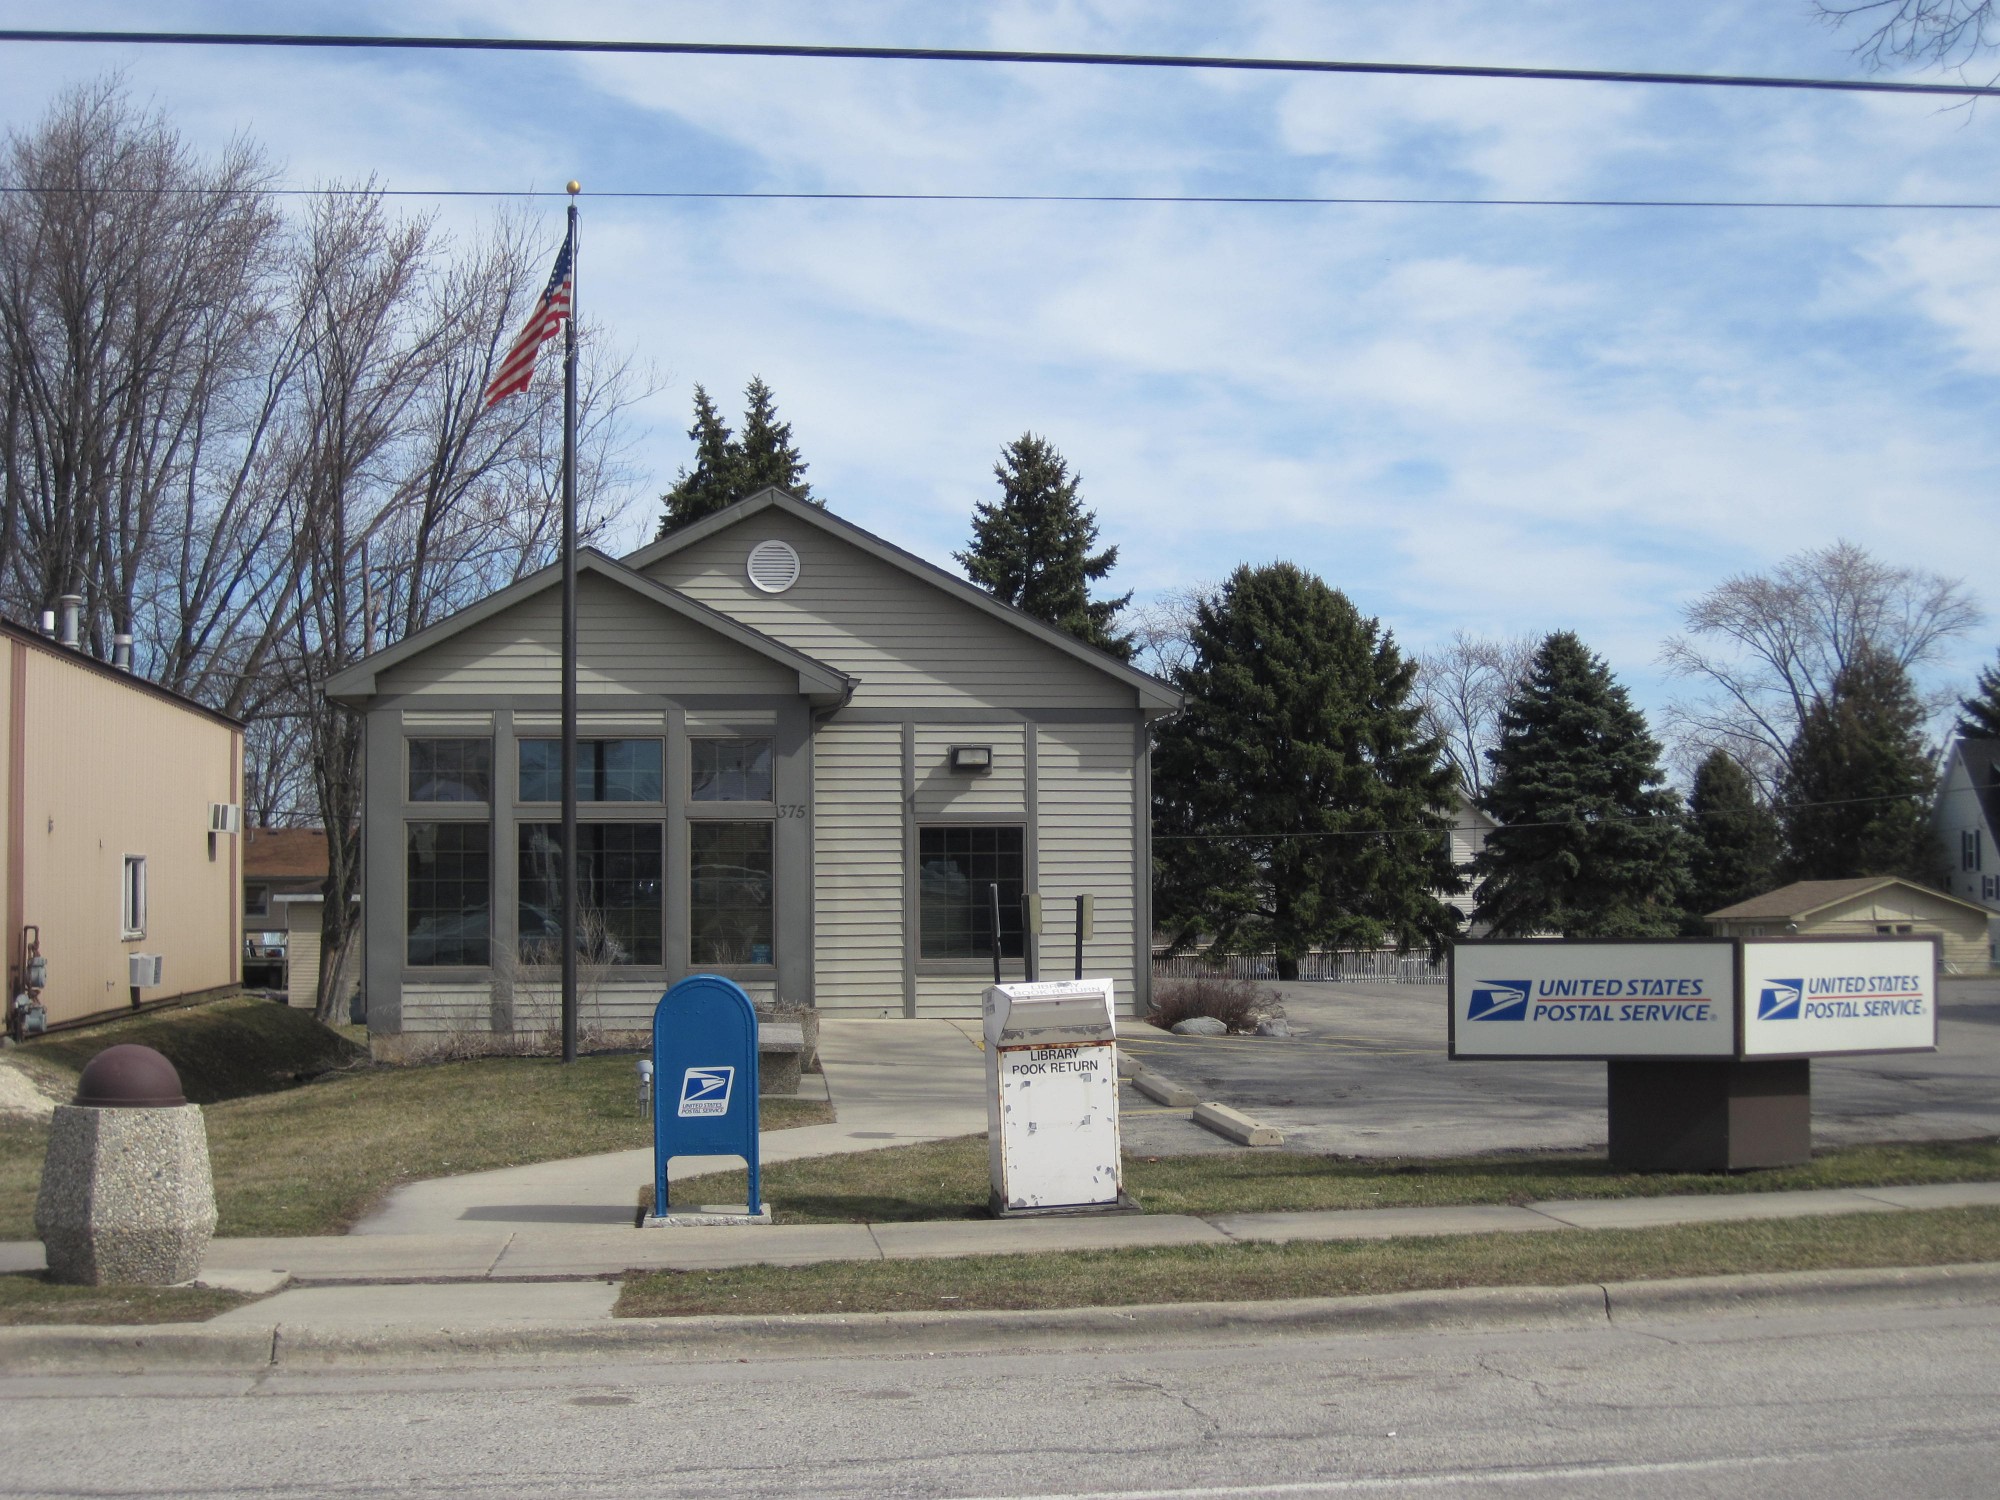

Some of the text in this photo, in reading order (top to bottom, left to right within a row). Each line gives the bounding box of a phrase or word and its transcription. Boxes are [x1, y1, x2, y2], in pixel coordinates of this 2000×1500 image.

[777, 804, 806, 819] 375
[1538, 979, 1703, 996] UNITED STATES
[1808, 975, 1920, 994] UNITED STATES
[1533, 1004, 1614, 1022] POSTAL
[1804, 1001, 1860, 1019] POSTAL
[1030, 1048, 1079, 1061] LIBRARY
[1050, 1060, 1098, 1073] RETURN
